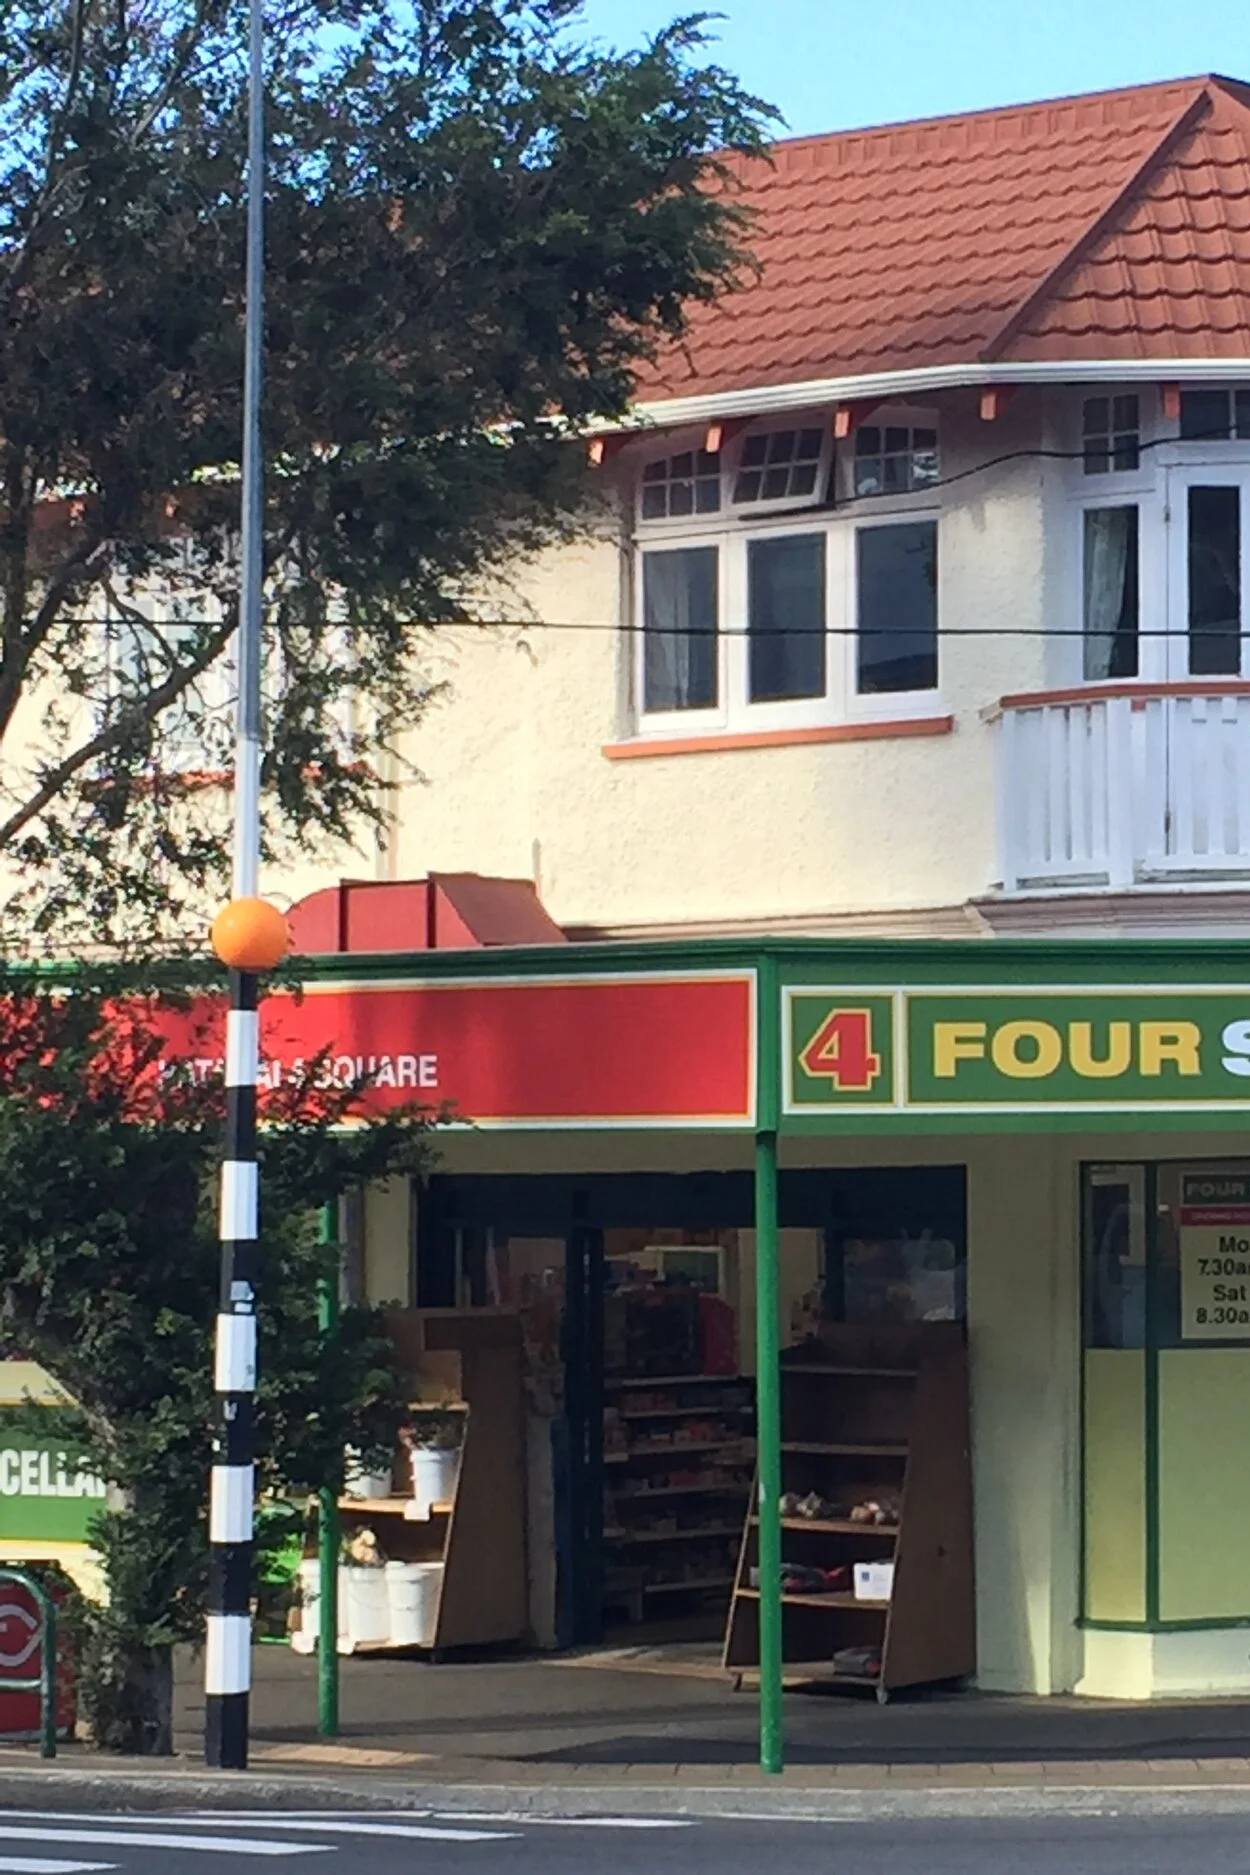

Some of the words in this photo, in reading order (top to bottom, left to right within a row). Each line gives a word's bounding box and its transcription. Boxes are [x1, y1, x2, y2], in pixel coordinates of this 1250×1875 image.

[799, 1008, 881, 1091] 4
[934, 1020, 1202, 1078] FOUR
[1186, 1182, 1246, 1197] FOUR
[1213, 1284, 1247, 1301] Sat
